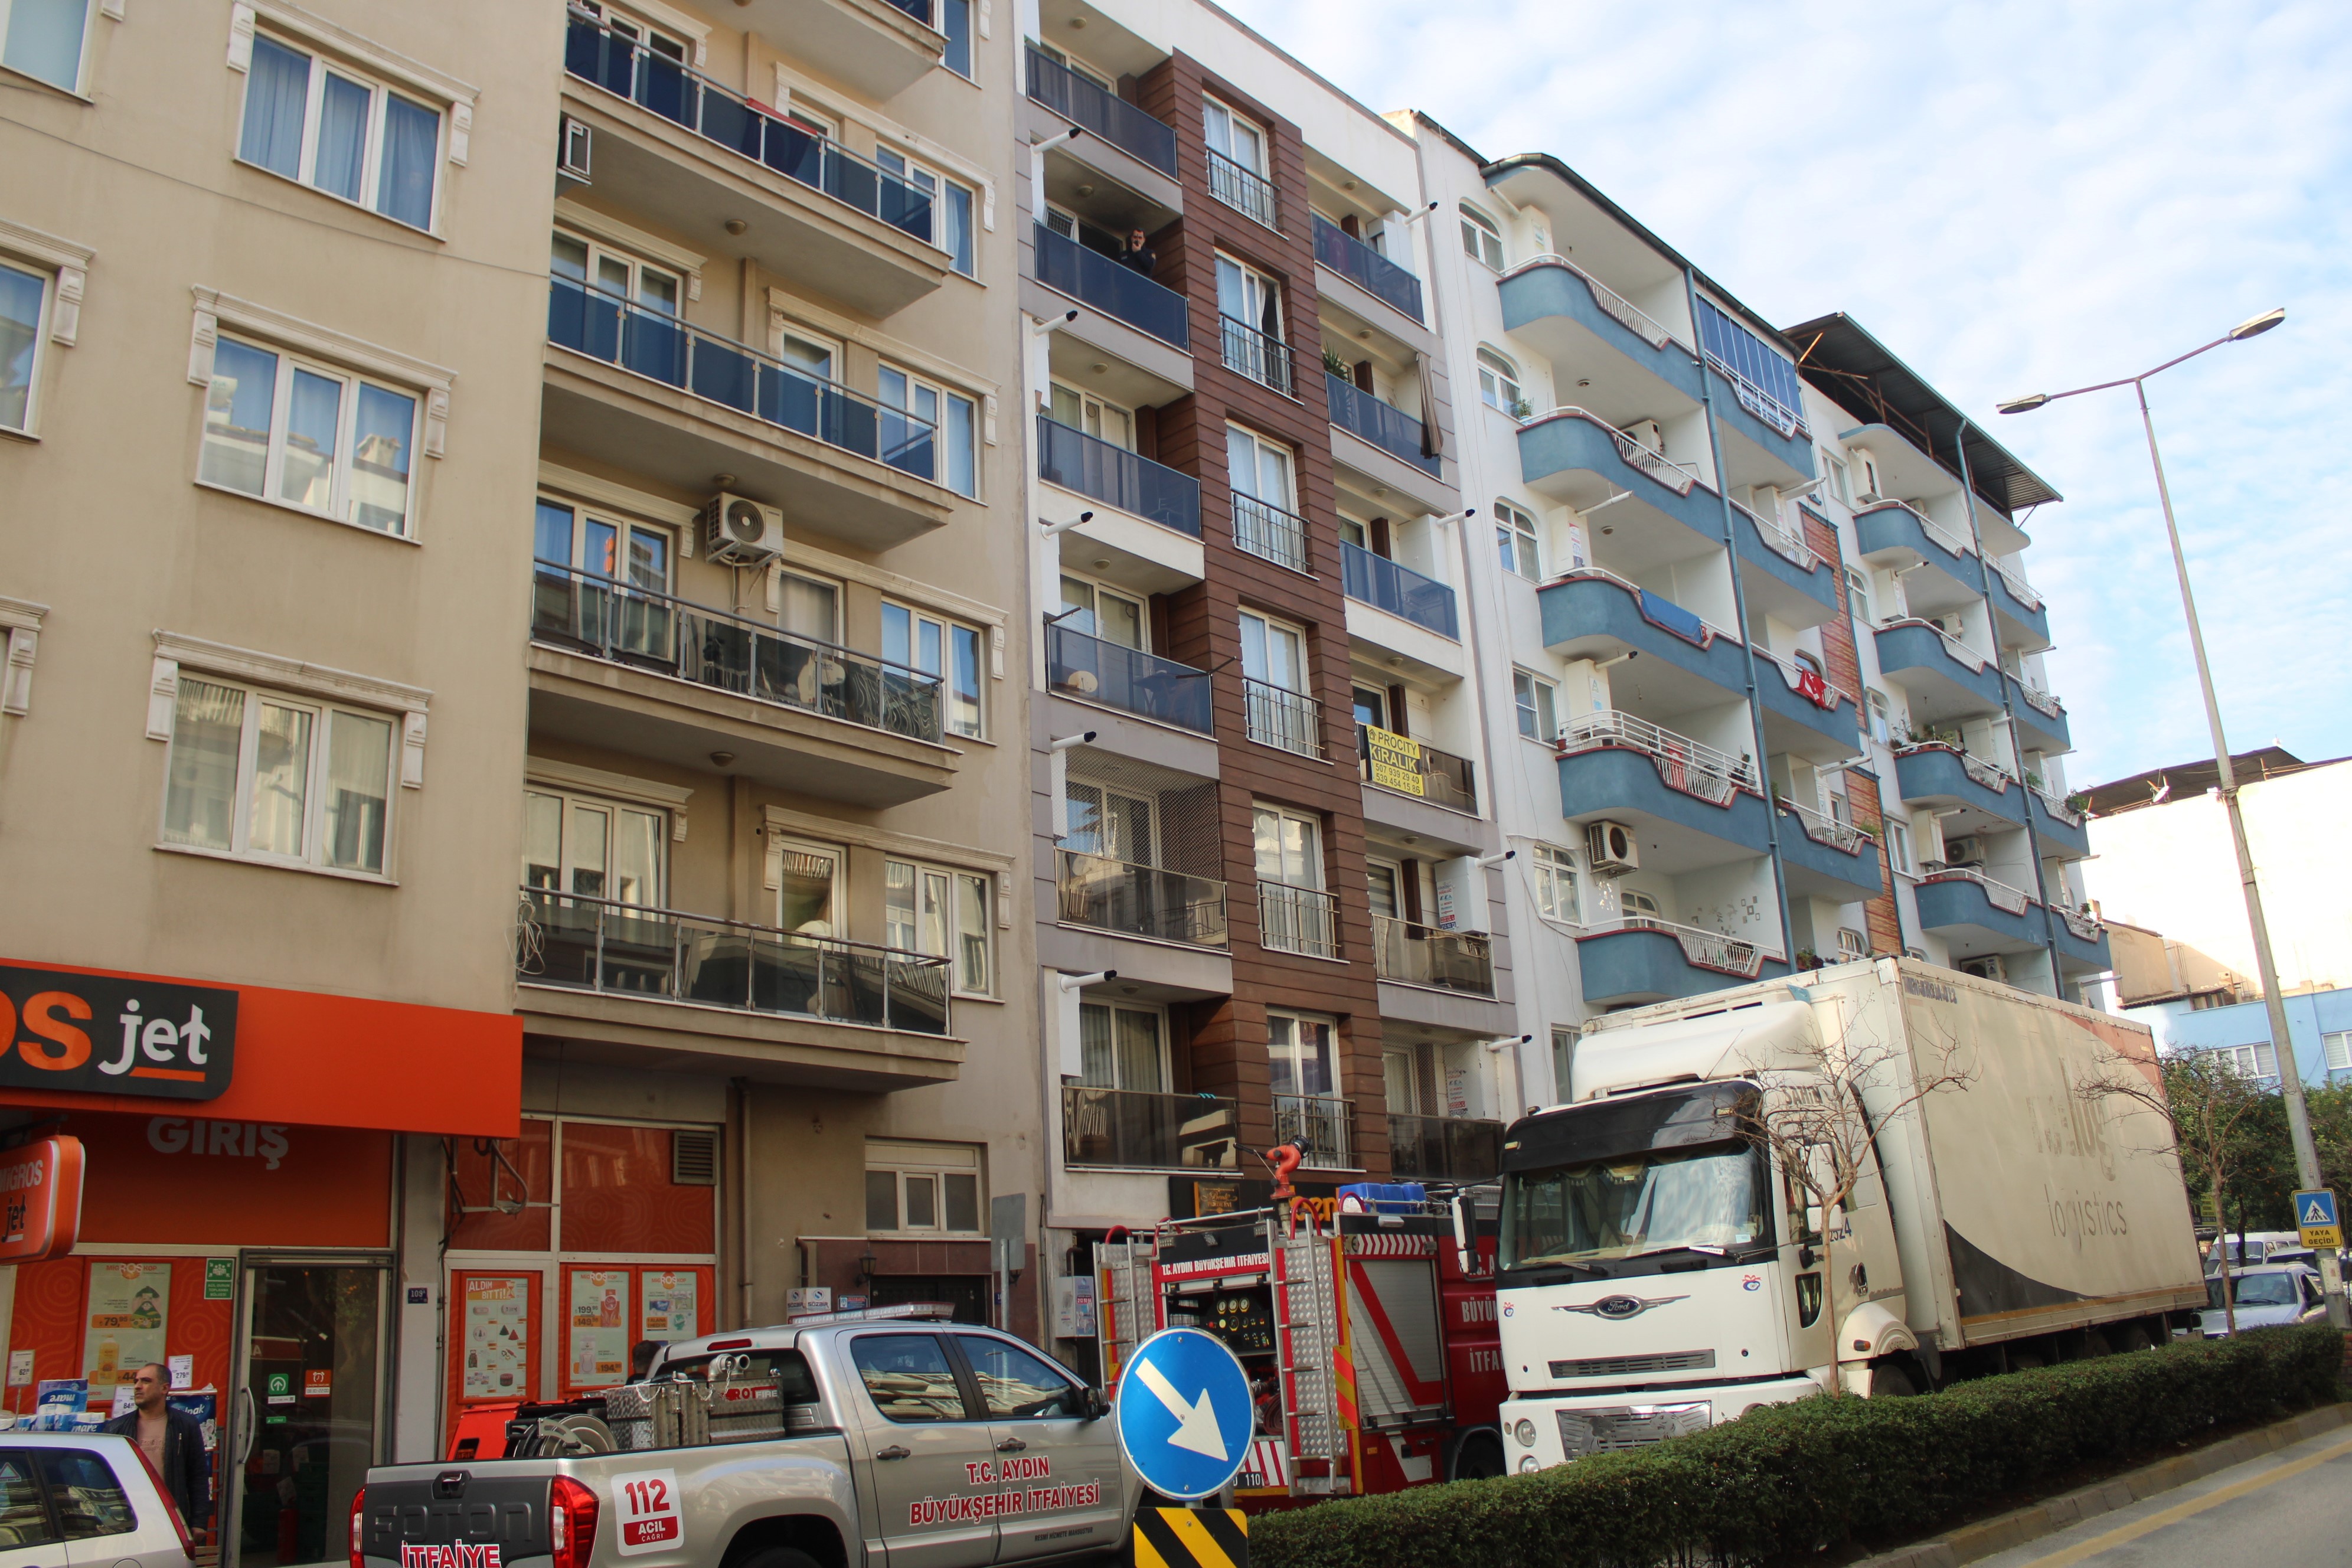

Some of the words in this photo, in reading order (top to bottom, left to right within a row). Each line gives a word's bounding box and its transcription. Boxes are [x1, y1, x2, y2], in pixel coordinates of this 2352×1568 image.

[1378, 731, 1417, 755] PROCITY
[1376, 763, 1387, 773] 507
[1389, 767, 1400, 778] 939
[1402, 772, 1410, 781] 29
[1412, 775, 1419, 784] 40
[1376, 773, 1387, 783] 539
[1389, 777, 1401, 788] 454
[1403, 782, 1410, 791] 15
[1412, 785, 1420, 794] 86
[0, 989, 92, 1071] S
[97, 998, 211, 1075] jet
[2, 1194, 27, 1243] jet
[2044, 1184, 2127, 1250] logistics
[1162, 1264, 1172, 1276] T.C.
[1172, 1261, 1193, 1275] AYDIN
[468, 1280, 492, 1292] ALDIM
[1608, 1300, 1630, 1312] Ford
[965, 1461, 998, 1485] T.C.
[1001, 1455, 1050, 1482] AYDIN
[1246, 1474, 1260, 1486] 110
[625, 1479, 670, 1515] 112
[910, 1488, 1024, 1525] BÜYÜKŞEHİR
[1027, 1478, 1100, 1512] İTFAİYESİ
[642, 1533, 663, 1542] ÇAĞRI
[401, 1539, 502, 1568] İTFAİYE
